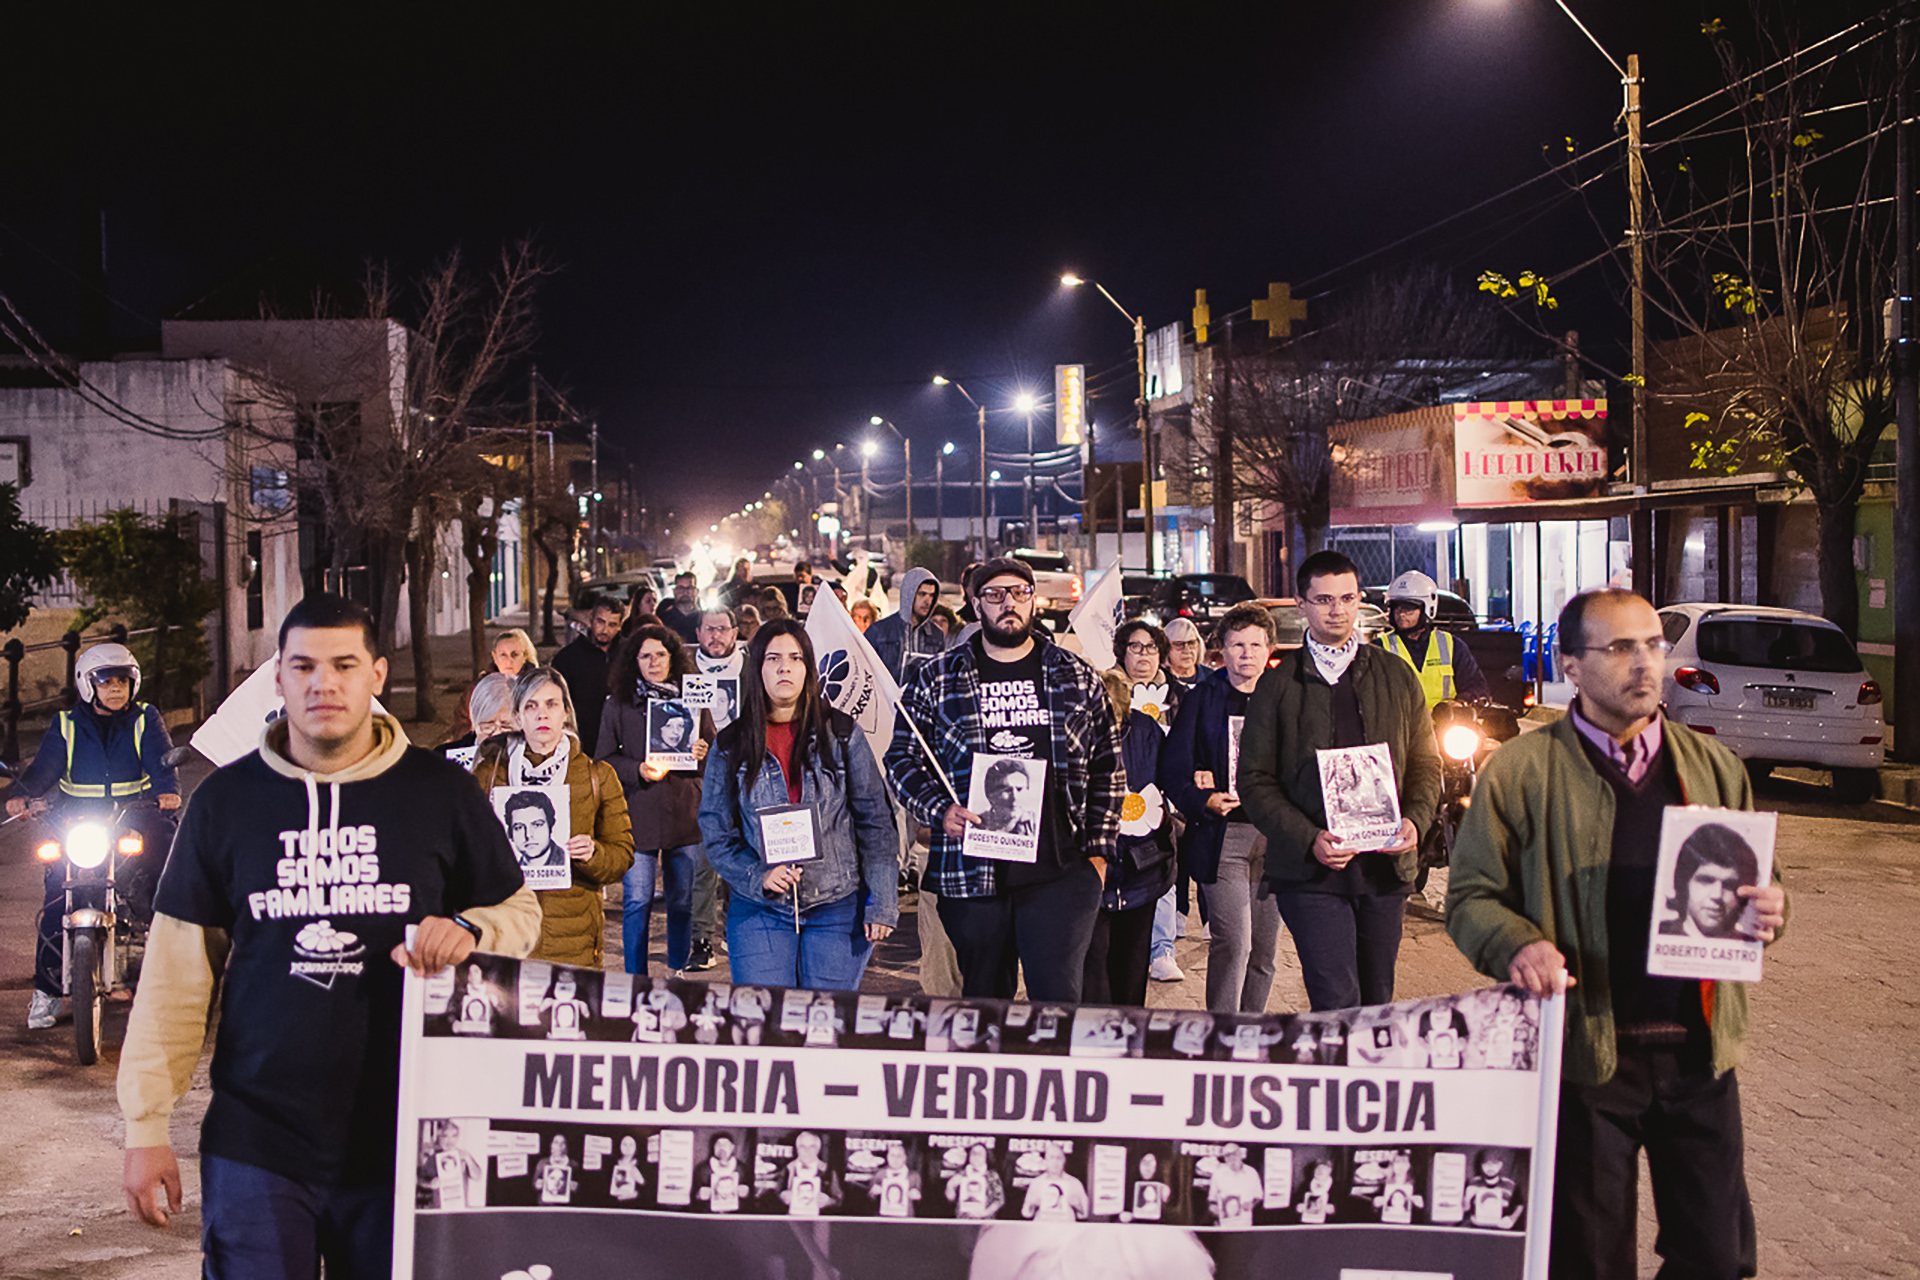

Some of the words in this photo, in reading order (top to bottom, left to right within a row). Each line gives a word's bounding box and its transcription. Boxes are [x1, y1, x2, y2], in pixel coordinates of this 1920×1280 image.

[980, 680, 1036, 697] TODOS
[980, 695, 1040, 712] SOMOS
[981, 709, 1050, 728] MILIARE
[279, 825, 377, 858] TODOS
[276, 854, 380, 888] SOMOS
[248, 883, 411, 920] FAMILIARES
[1655, 943, 1707, 959] ROBERTO
[1711, 948, 1758, 963] CASTRO
[522, 1052, 800, 1115] MEMORIA
[882, 1062, 1109, 1123] VERDAD
[1186, 1074, 1436, 1133] JUSTICIA
